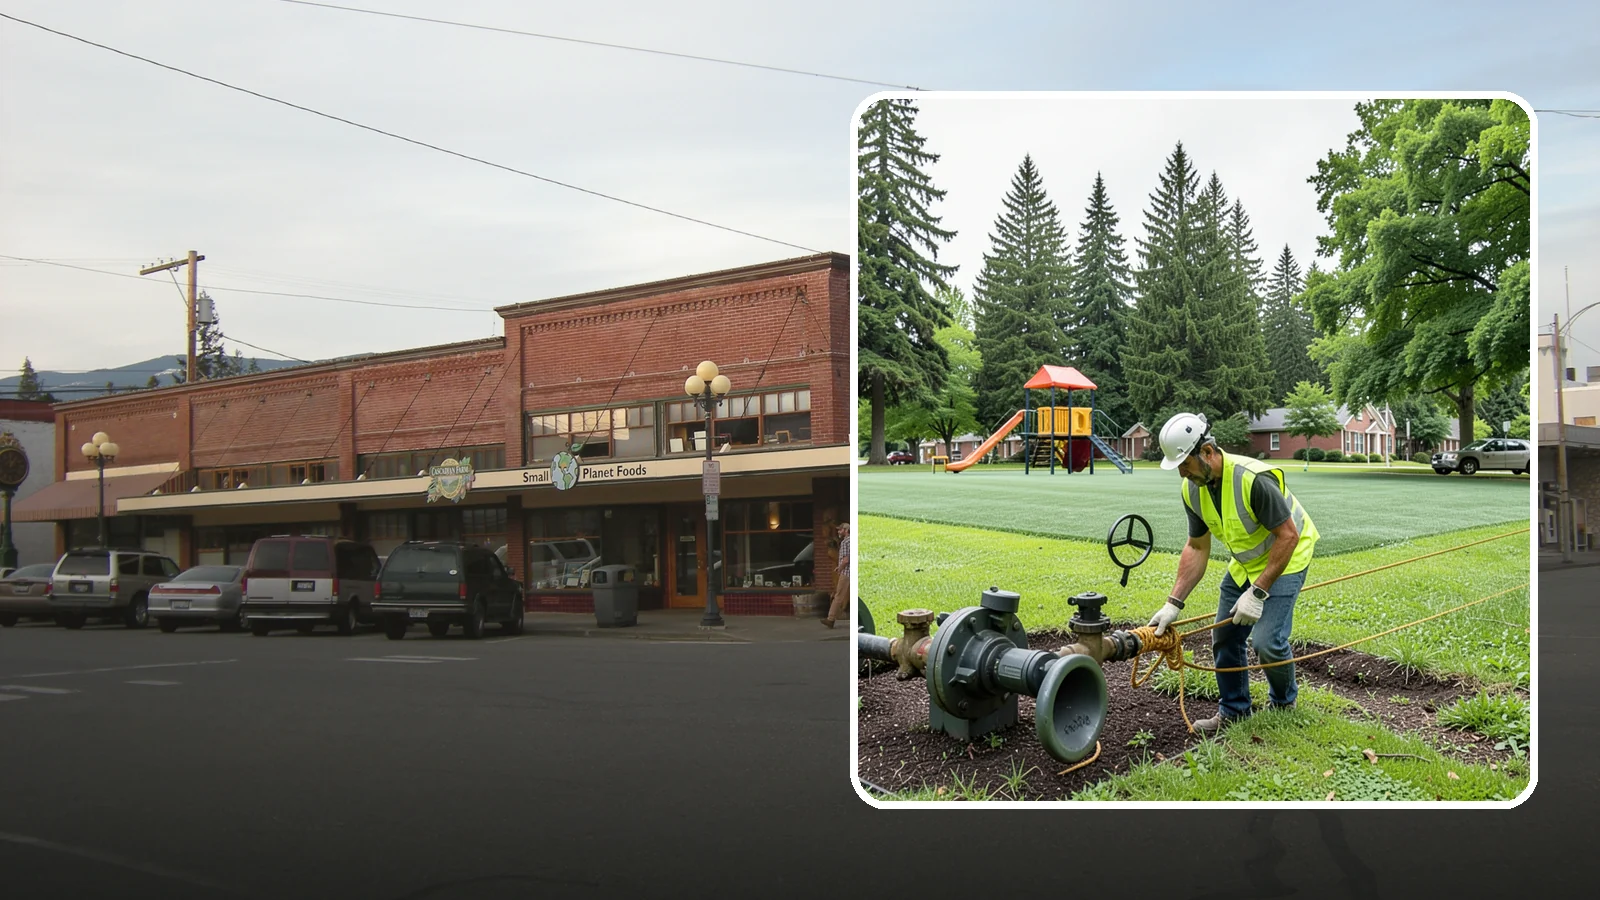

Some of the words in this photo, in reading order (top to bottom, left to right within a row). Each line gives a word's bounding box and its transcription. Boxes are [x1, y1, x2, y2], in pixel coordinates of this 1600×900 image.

[431, 466, 456, 476] CASCADIAN
[522, 471, 549, 483] Small
[582, 468, 614, 479] Planet
[617, 464, 647, 477] Foods
